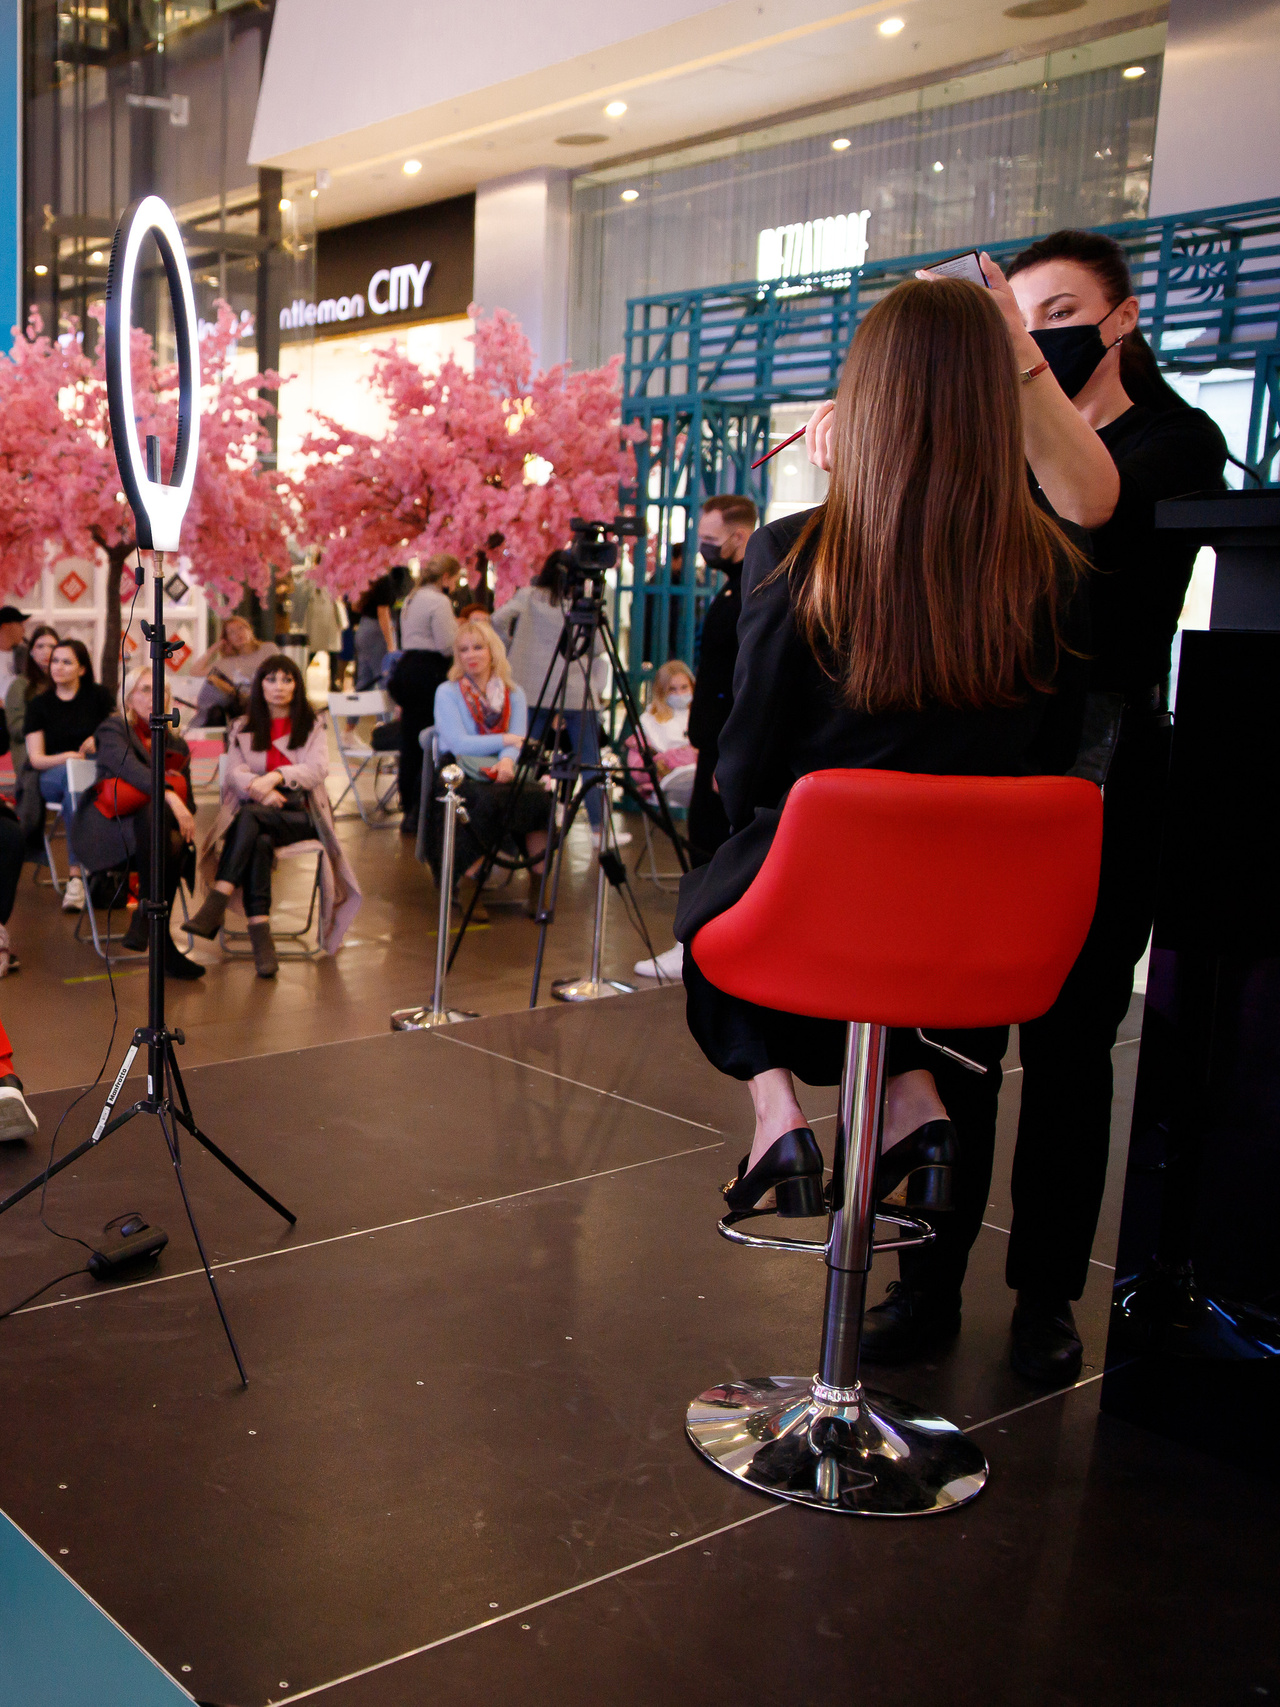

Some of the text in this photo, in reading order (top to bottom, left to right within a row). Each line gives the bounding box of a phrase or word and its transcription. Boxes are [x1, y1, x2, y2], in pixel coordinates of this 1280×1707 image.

[279, 293, 366, 330] ntleman
[367, 260, 433, 315] CITY
[109, 1068, 127, 1102] Manfrotto
